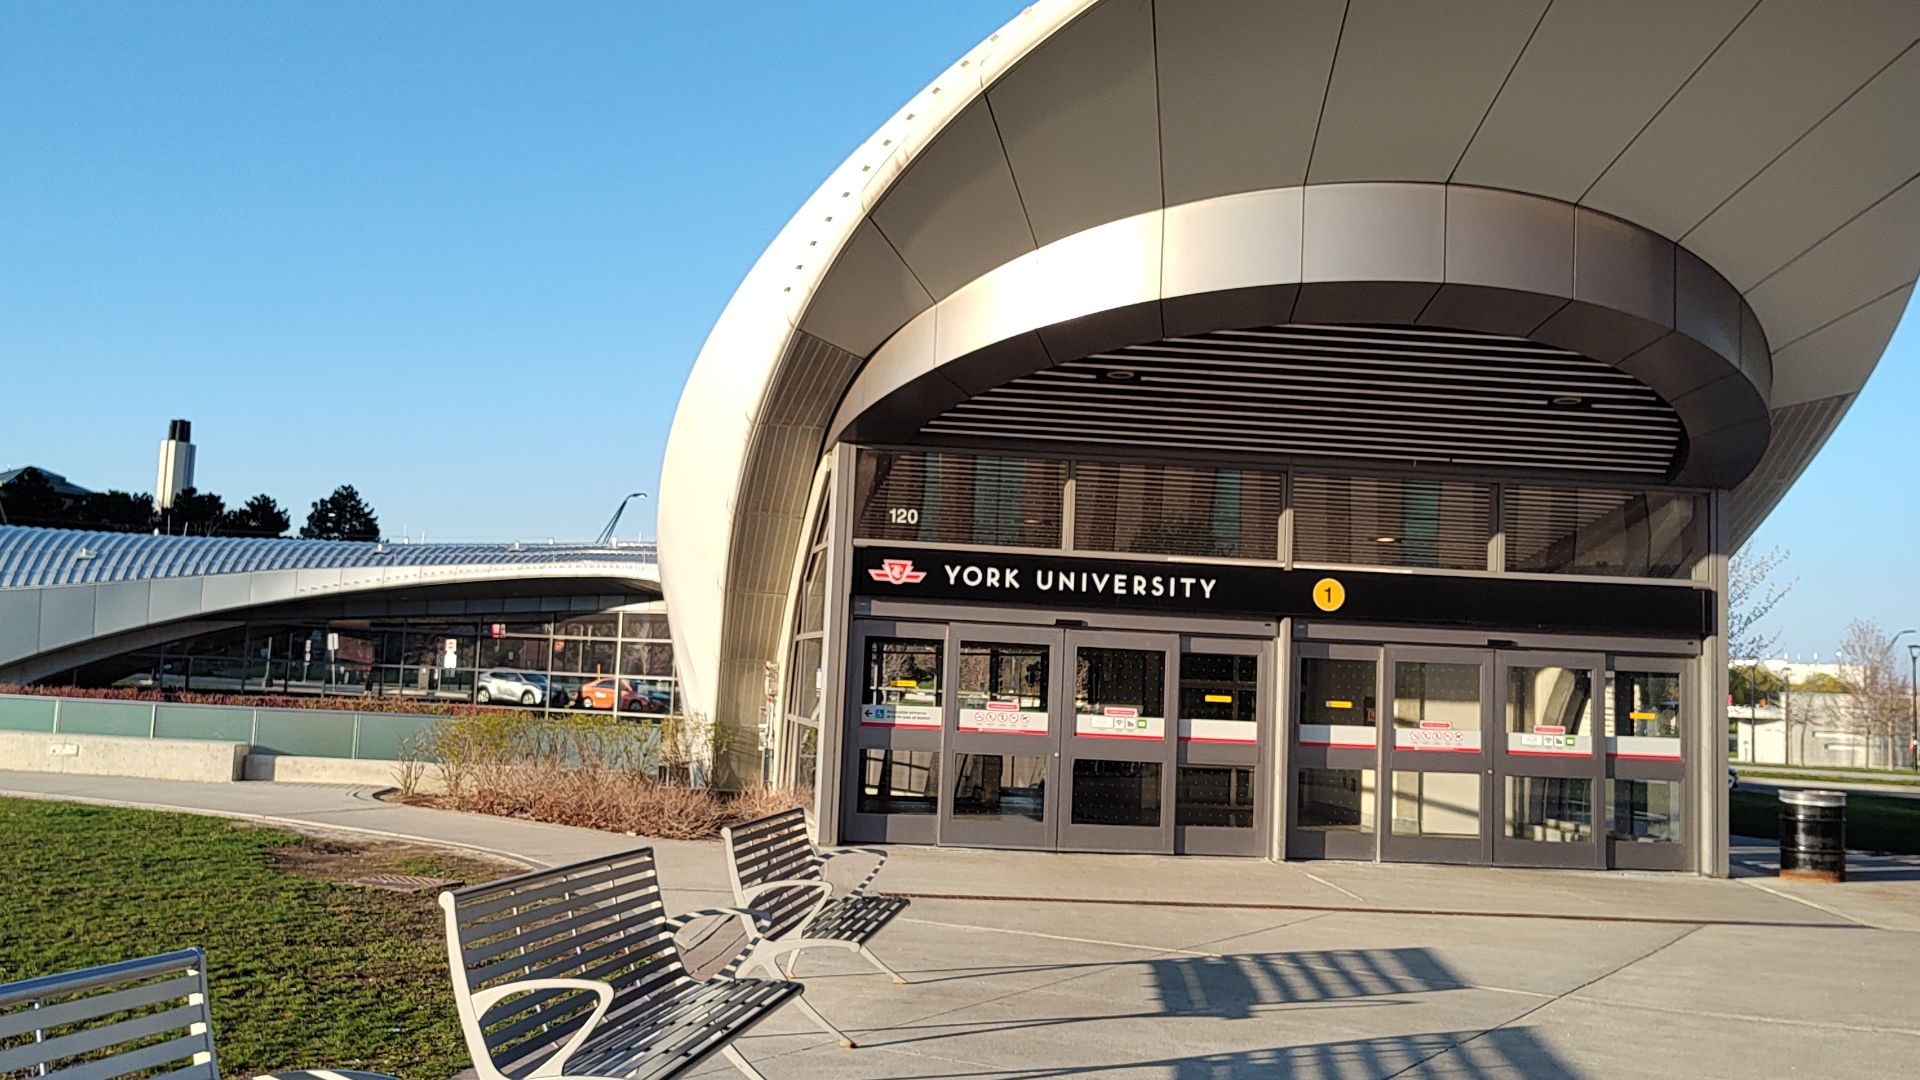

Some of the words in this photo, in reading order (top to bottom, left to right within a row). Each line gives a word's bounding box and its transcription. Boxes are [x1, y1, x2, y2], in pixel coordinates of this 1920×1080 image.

[889, 508, 919, 525] 120
[944, 564, 1020, 589] YORK
[1036, 569, 1217, 599] UNIVERSITY
[1323, 587, 1332, 604] 1
